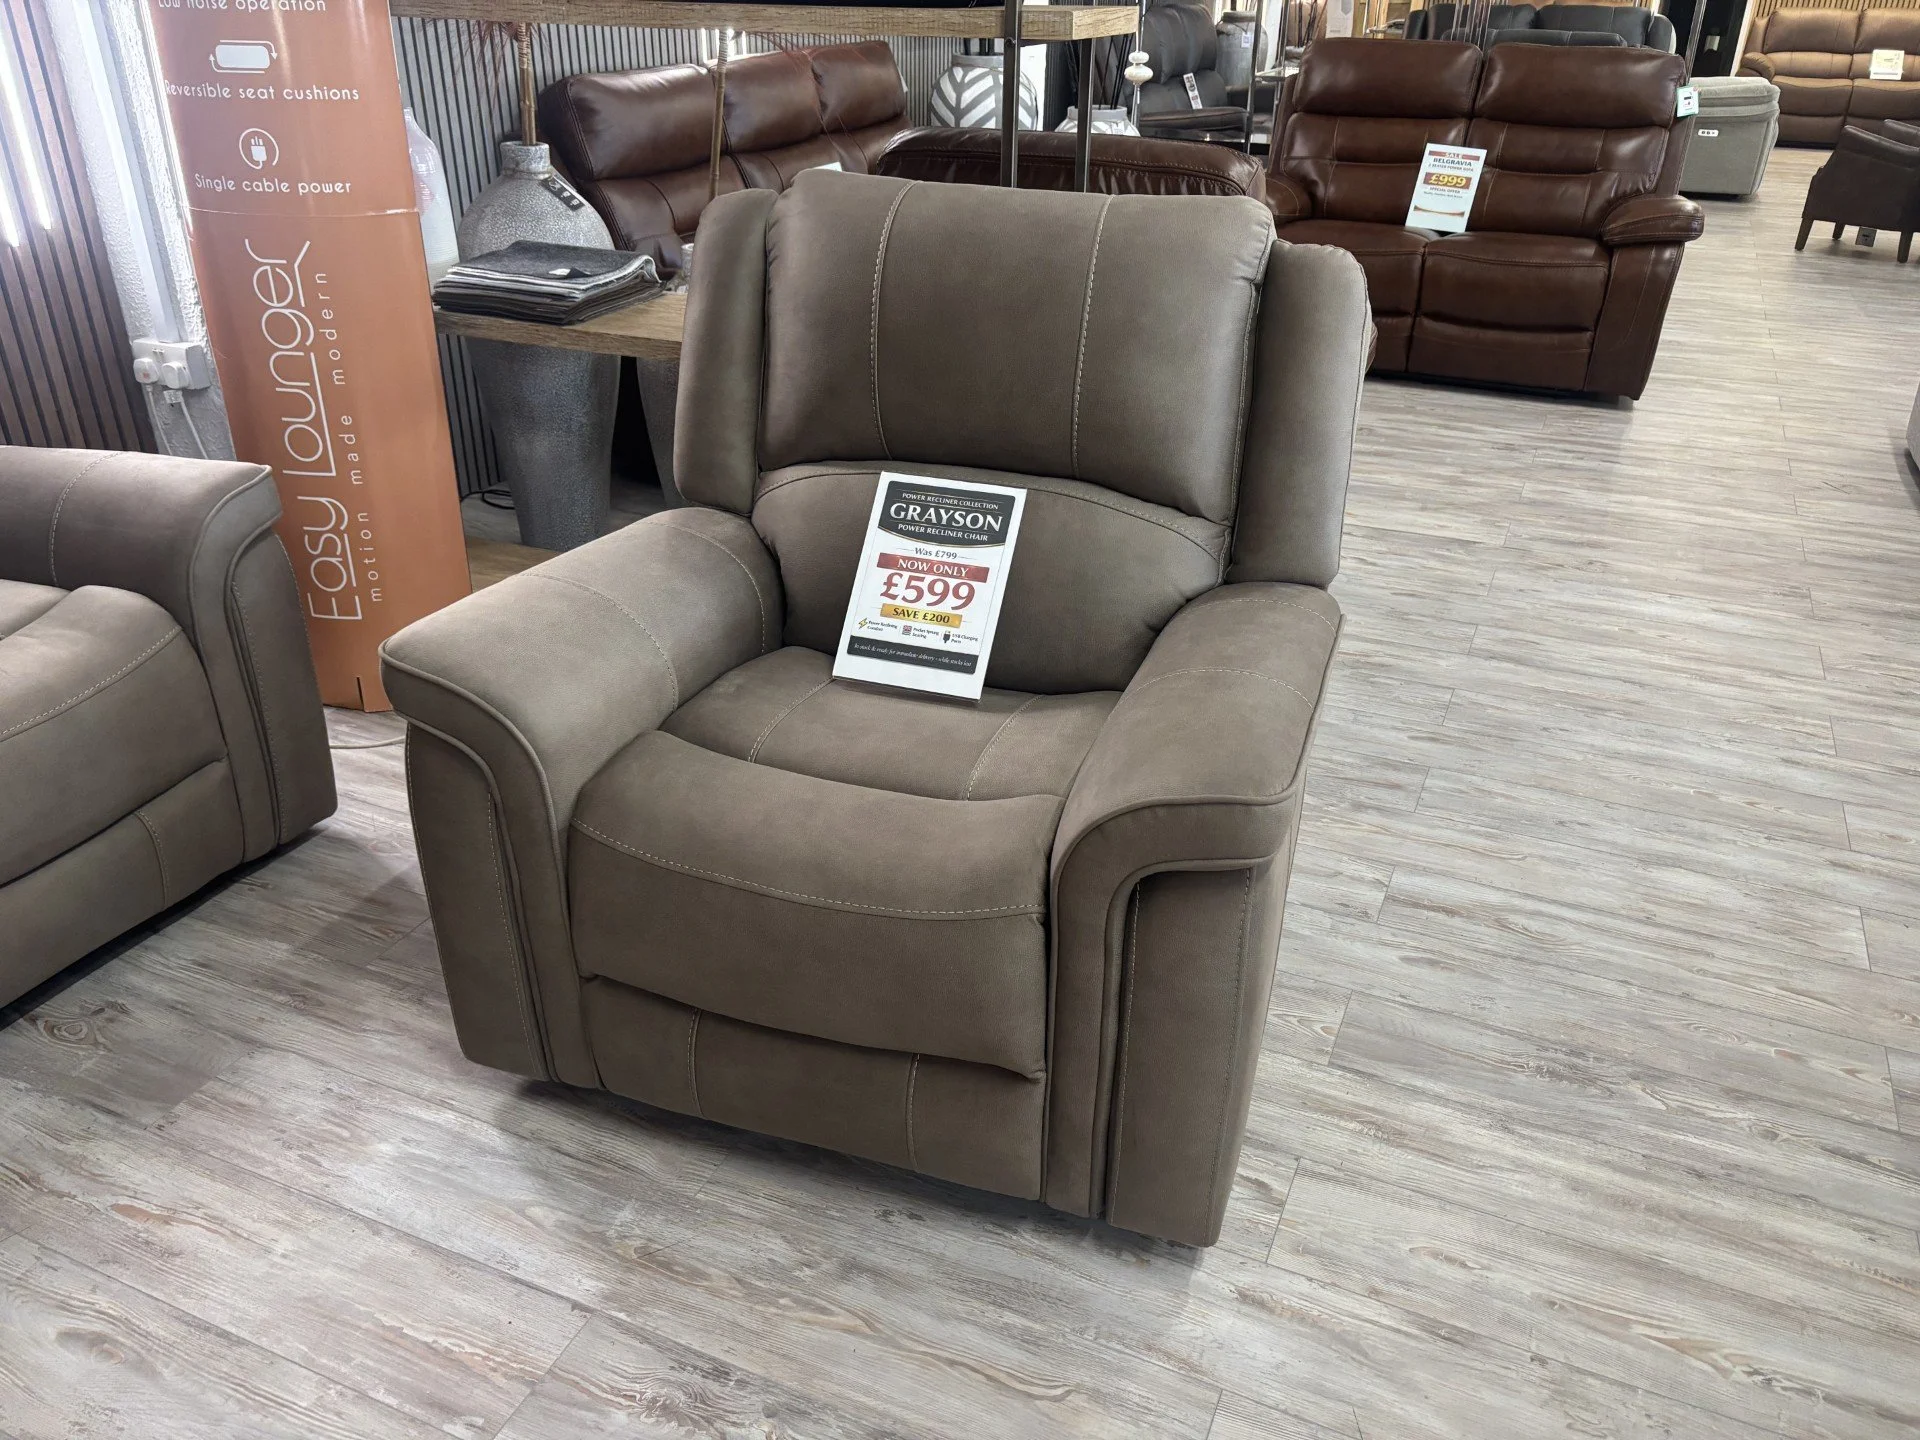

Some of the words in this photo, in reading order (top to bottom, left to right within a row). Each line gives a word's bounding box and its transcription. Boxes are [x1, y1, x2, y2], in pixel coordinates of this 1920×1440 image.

[235, 0, 327, 13] operation
[164, 81, 232, 99] Reversible
[239, 86, 276, 100] seat
[282, 84, 360, 101] cushions
[1433, 158, 1472, 167] BELGRAVIA
[194, 173, 236, 192] Single
[242, 177, 290, 193] cable
[298, 180, 352, 196] power
[1429, 173, 1467, 187] £999
[314, 272, 346, 385] modern
[245, 238, 337, 477] Lounger
[340, 414, 364, 485] made
[902, 492, 926, 501] POWER
[926, 496, 959, 506] RECLINER
[959, 500, 999, 510] COLLECTION
[889, 502, 1003, 532] GRAYSON
[898, 523, 925, 533] POWER
[926, 528, 964, 539] RECLINER
[964, 531, 989, 542] CHAIR
[297, 496, 363, 620] Easy
[357, 511, 383, 602] motion
[914, 547, 933, 557] Was
[934, 550, 958, 560] £799
[897, 558, 932, 572] NOW
[933, 564, 970, 577] ONLY
[880, 572, 976, 611] £599
[892, 607, 921, 620] SAVE
[922, 613, 951, 624] £200
